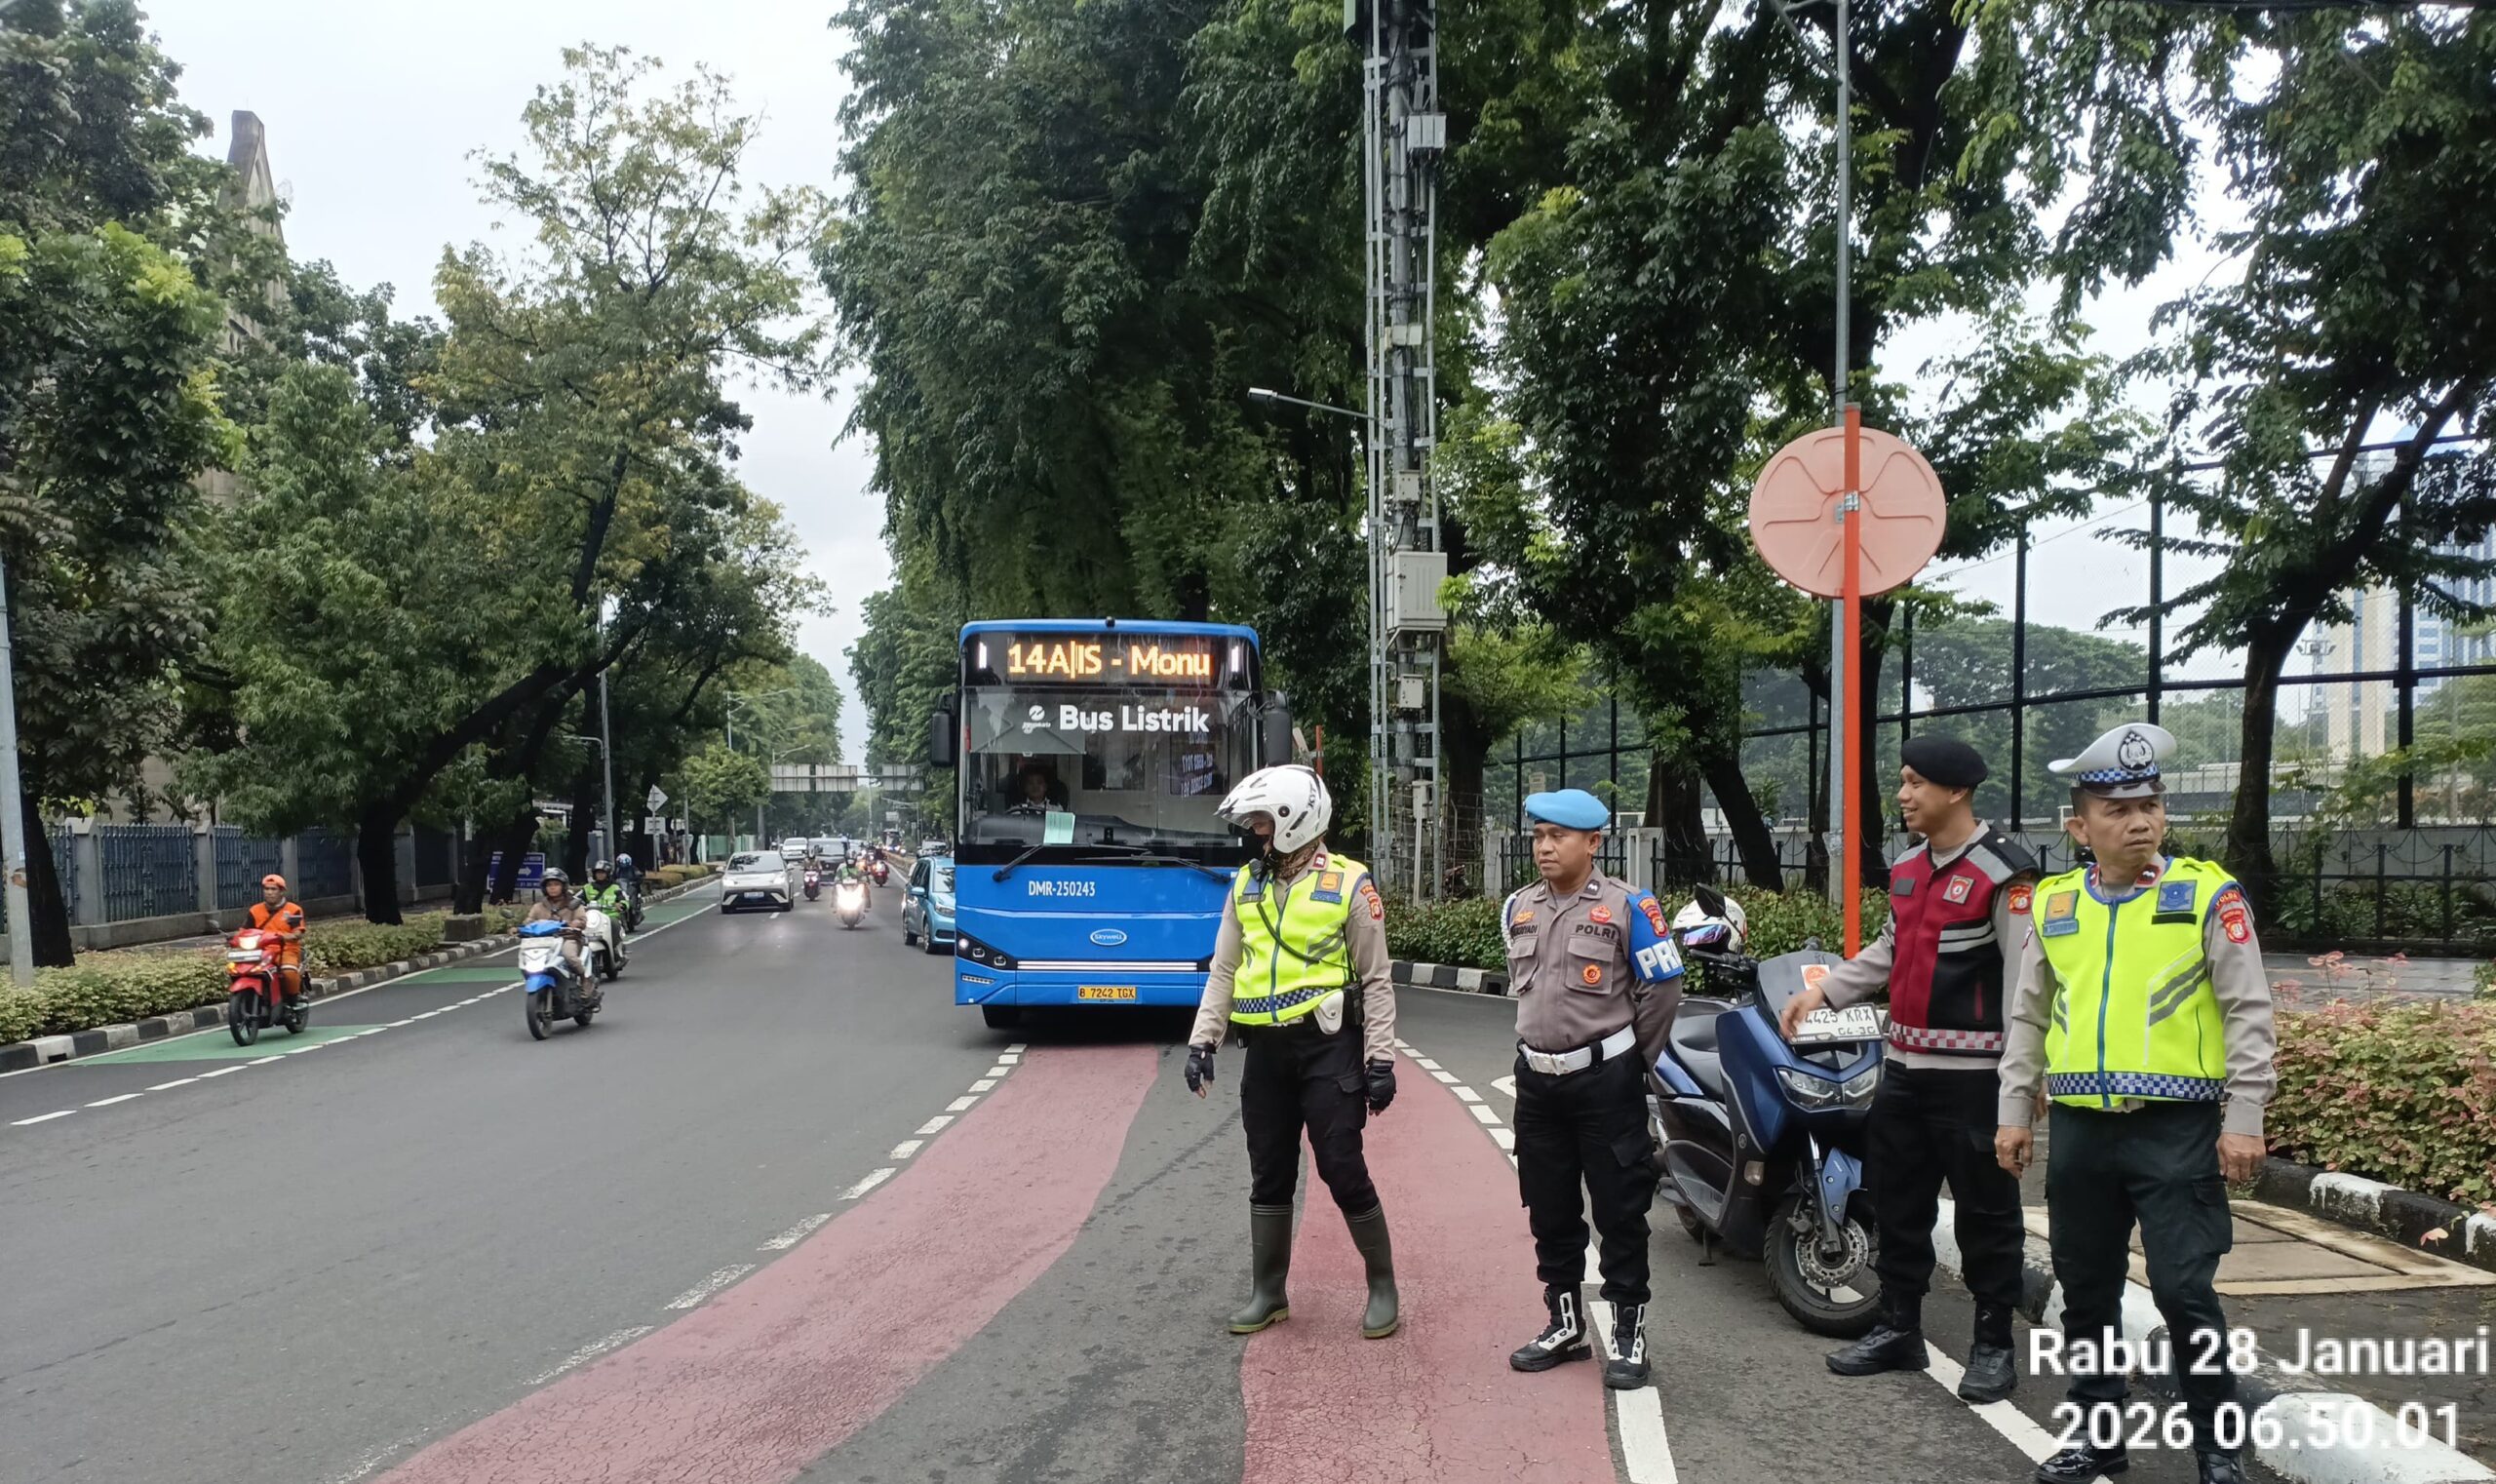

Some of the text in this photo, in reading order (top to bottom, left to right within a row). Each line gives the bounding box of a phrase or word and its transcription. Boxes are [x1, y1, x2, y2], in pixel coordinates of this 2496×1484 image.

[1111, 658, 1122, 667] -
[1131, 644, 1210, 676] Monu
[1060, 705, 1113, 731] Bus
[1122, 705, 1209, 732] Listrik
[1028, 880, 1096, 897] DMR-250243
[1576, 924, 1616, 939] POLRI
[1079, 988, 1135, 998] B 7242 TGX
[1804, 1008, 1872, 1024] 4425 KRX
